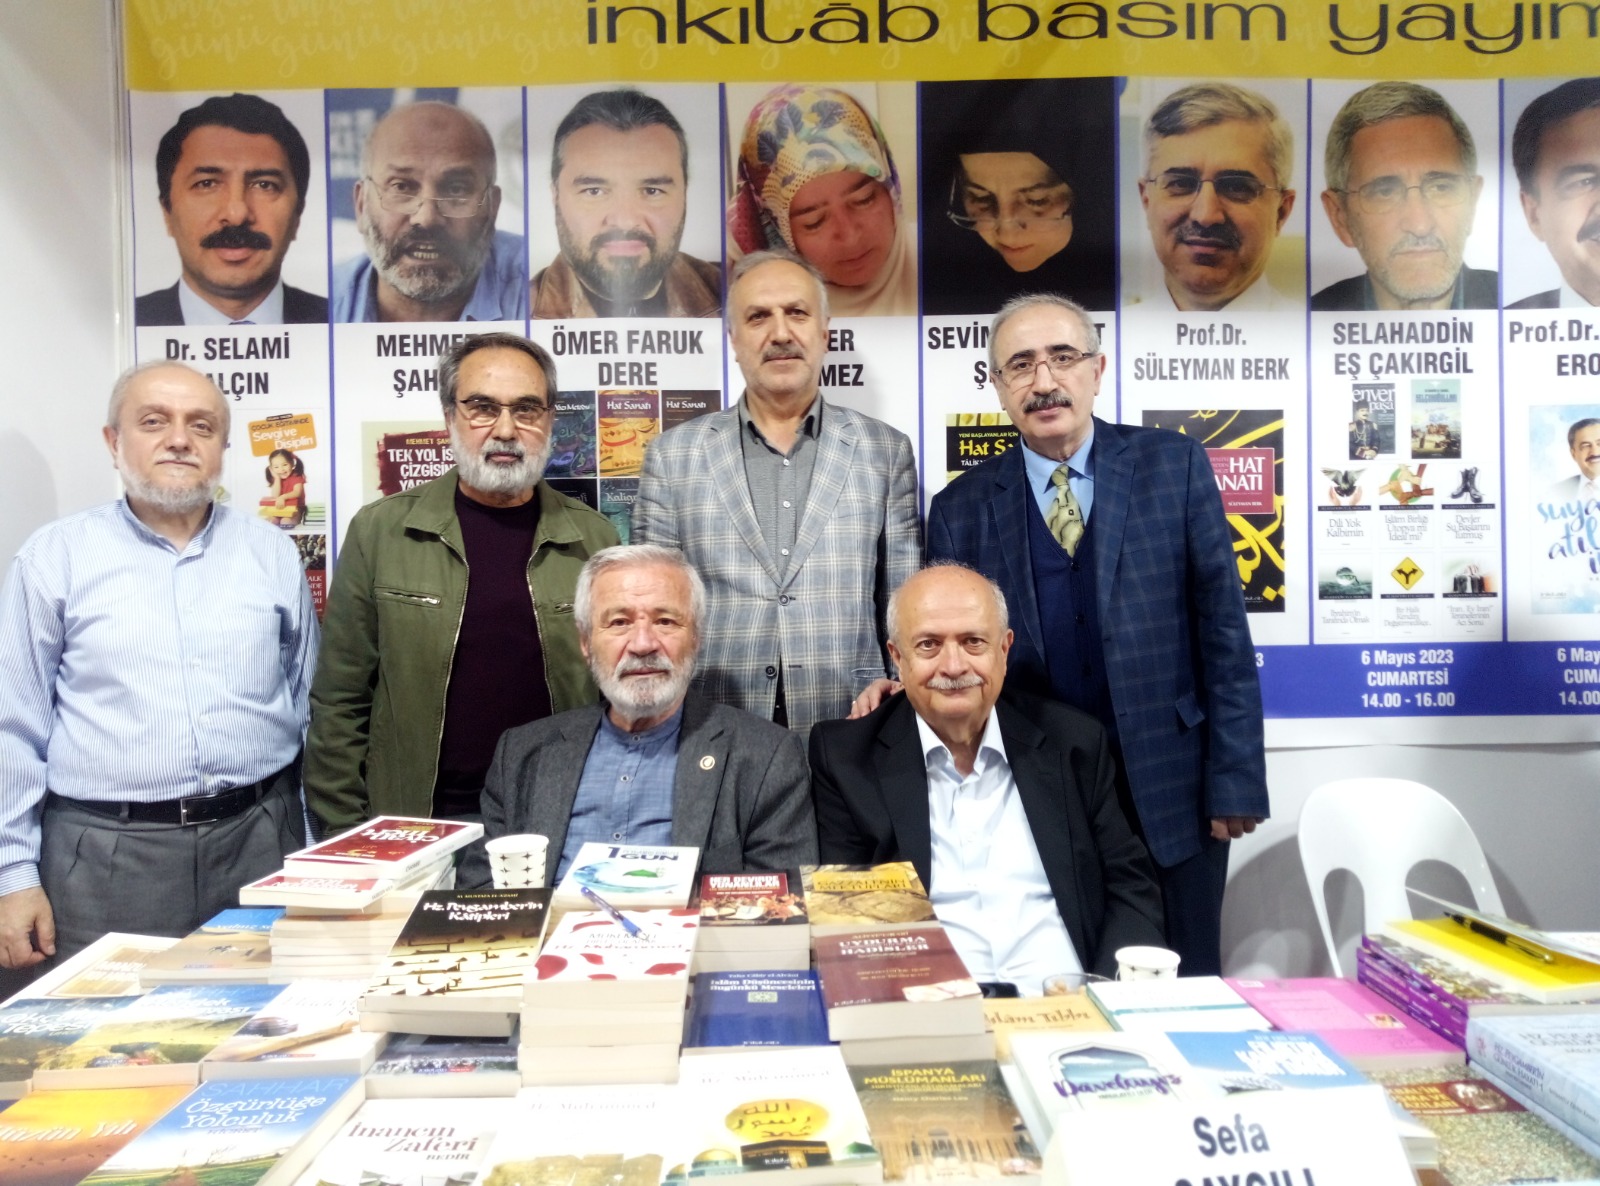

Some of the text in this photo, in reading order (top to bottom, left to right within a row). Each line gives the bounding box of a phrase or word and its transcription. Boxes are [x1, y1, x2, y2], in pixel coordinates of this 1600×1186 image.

[1333, 316, 1474, 345] SELAHADDİN
[166, 332, 290, 361] Dr. SELAMİ
[377, 333, 469, 358] MEHME
[552, 326, 704, 356] ÖMER FARUK
[827, 329, 855, 352] ER
[1134, 352, 1290, 381] SÜLEYMAN BERK
[1334, 347, 1474, 381] EŞ ÇAKIRGİL
[1557, 354, 1600, 376] ERO
[393, 368, 438, 398] ŞAH
[598, 362, 658, 387] DERE
[818, 364, 864, 387] MEZ
[206, 371, 270, 401] ALÇIN
[1352, 389, 1396, 402] enver
[607, 401, 651, 410] Hat Sanatı
[666, 401, 707, 409] Hat Sanatı
[1369, 402, 1395, 413] paşa
[252, 428, 298, 442] Sevgi ve
[274, 436, 313, 449] Disiplin
[387, 446, 454, 462] TEK YOL İS
[959, 440, 989, 456] Hat
[400, 462, 456, 479] ÇİZGİSİN
[1230, 456, 1266, 473] HAT
[606, 493, 638, 504] Kaligr
[1361, 649, 1454, 668] 6 Mayıs 2023
[1557, 648, 1600, 665] 6 May
[1367, 668, 1449, 687] CUMARTESİ
[1564, 669, 1600, 684] CUM
[1361, 693, 1402, 708] 14.00
[1414, 692, 1456, 707] 16.00
[423, 902, 445, 911] Hz.
[864, 1074, 987, 1085] MÜSLÜMANLARI
[186, 1095, 327, 1116] Özgürlüğe
[181, 1109, 305, 1129] Yolculuk
[383, 1136, 479, 1153] Zaferi
[1193, 1113, 1270, 1158] Sefa
